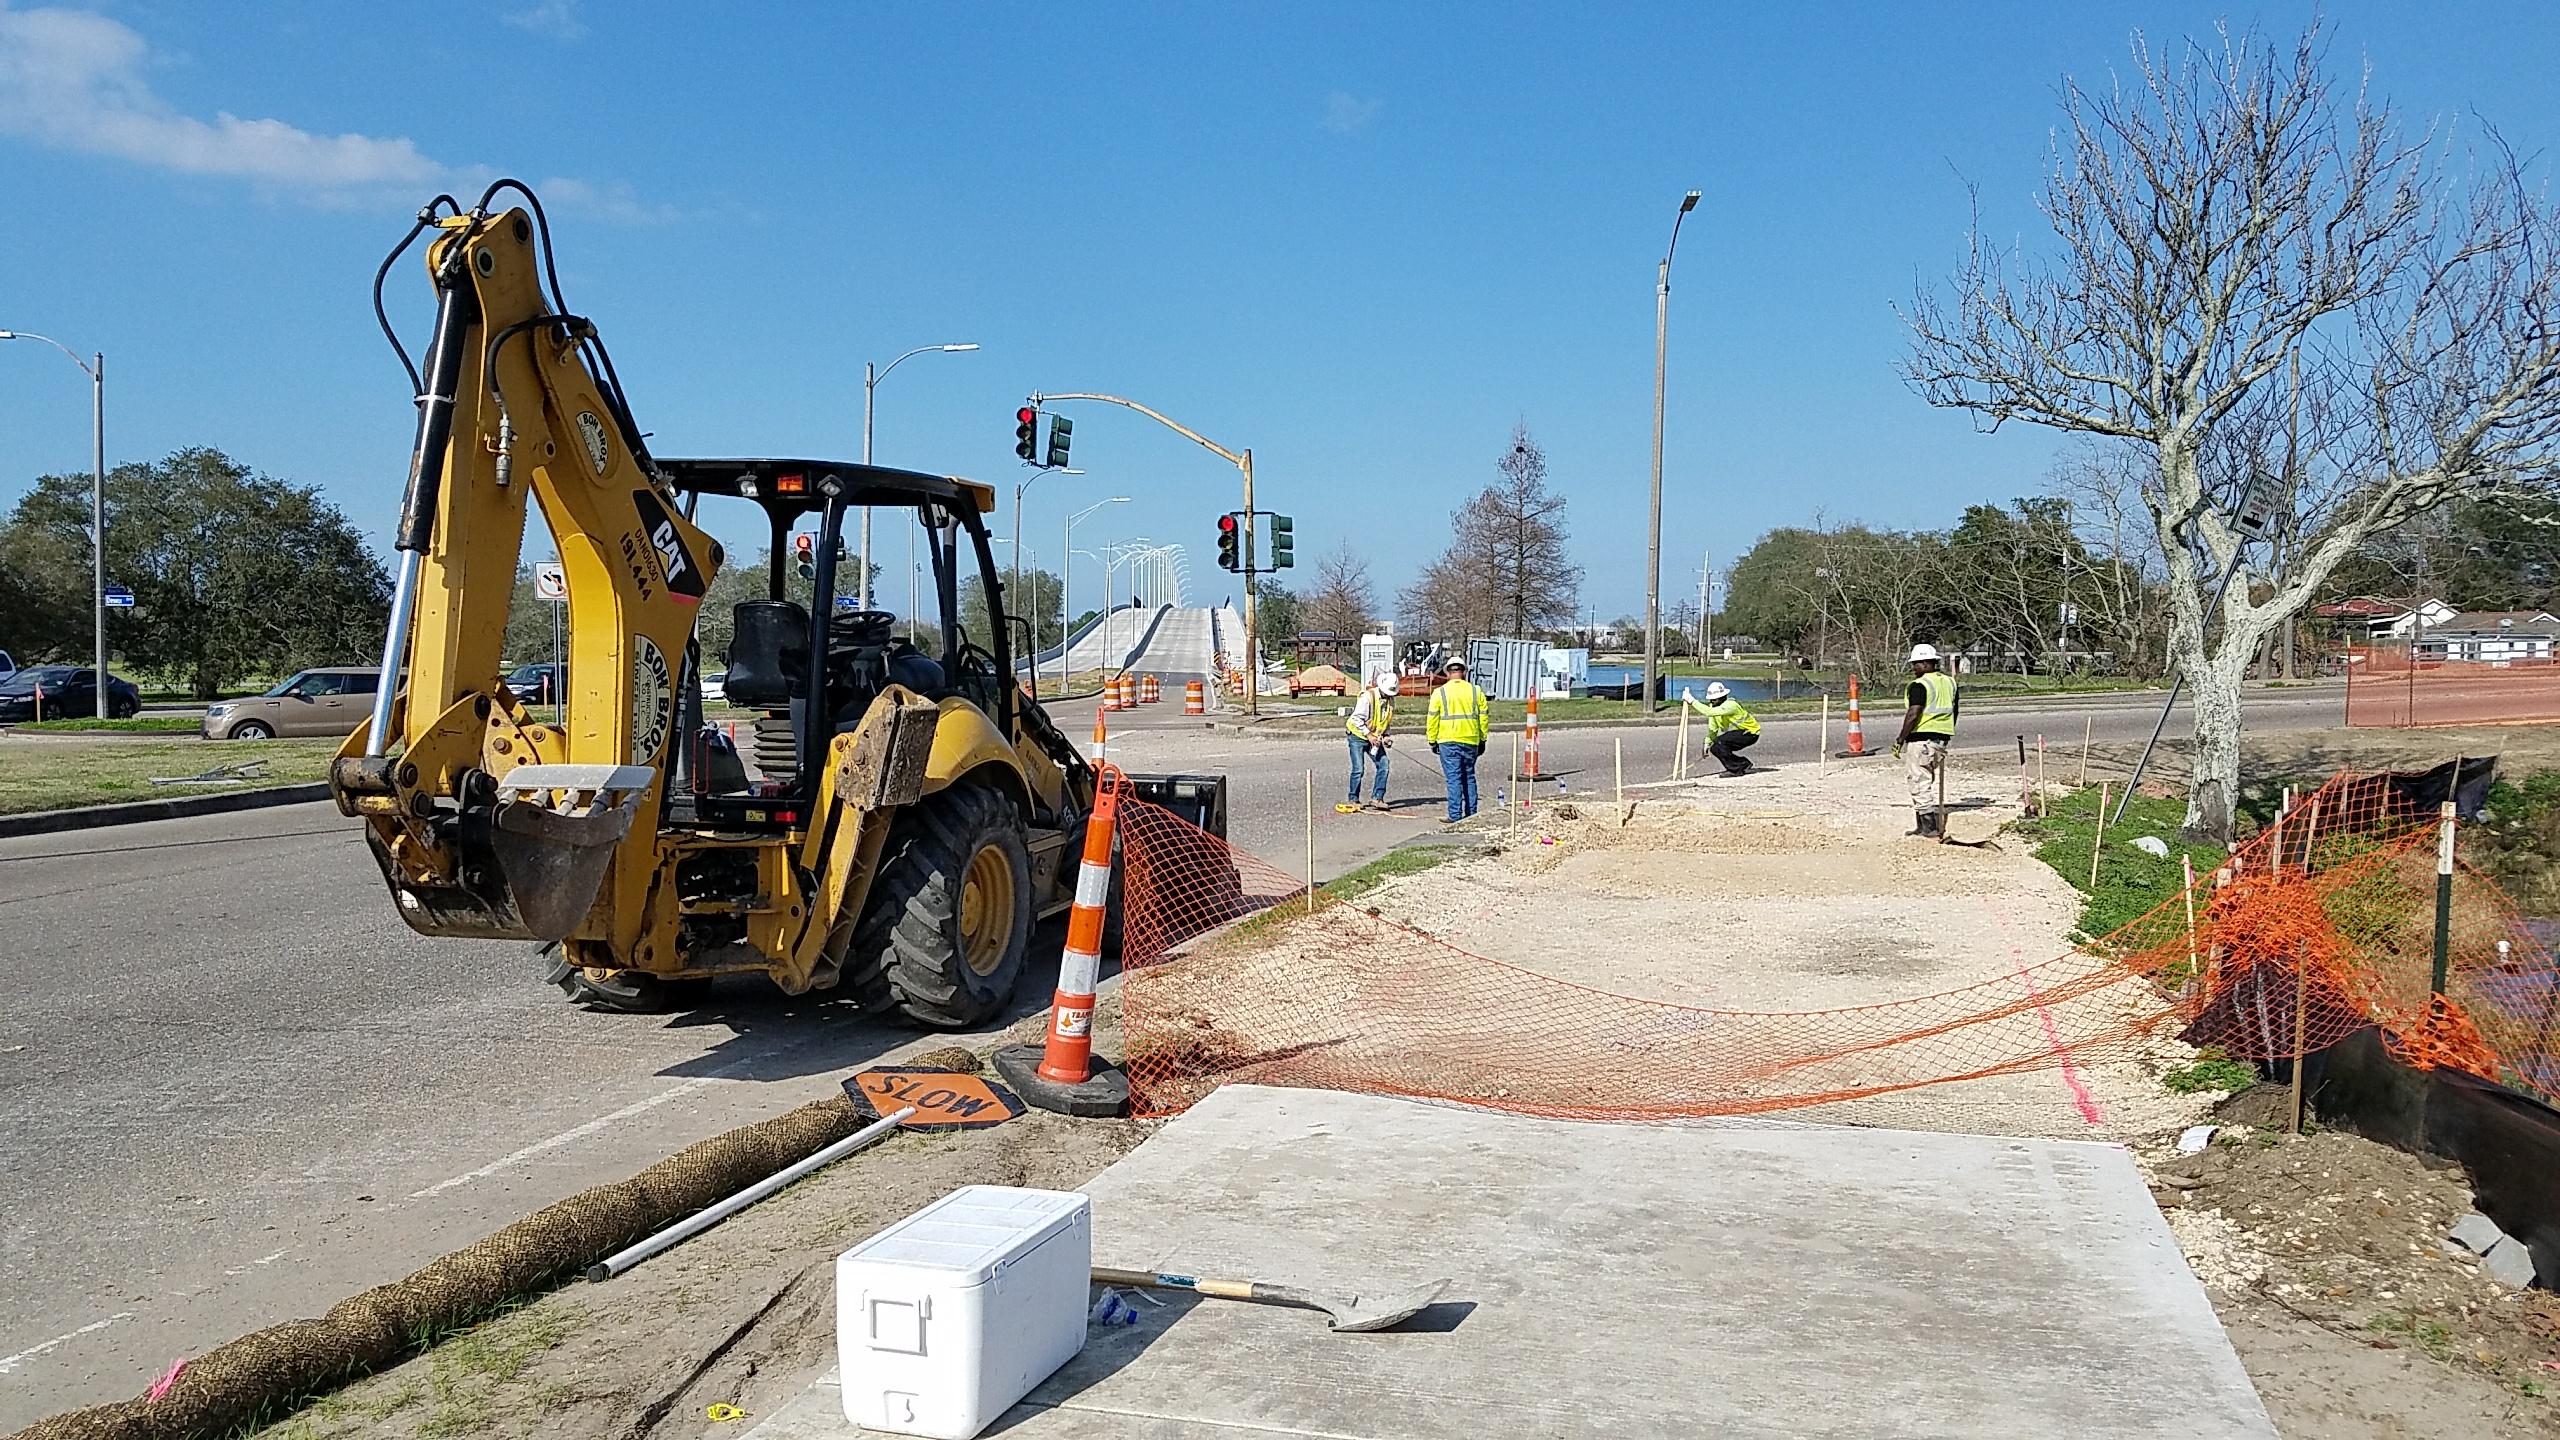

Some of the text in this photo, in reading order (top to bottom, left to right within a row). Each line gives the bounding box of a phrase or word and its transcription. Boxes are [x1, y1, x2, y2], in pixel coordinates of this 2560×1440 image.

[582, 413, 599, 430] BOH
[652, 519, 687, 584] CAT
[644, 642, 669, 690] BOH
[867, 1075, 996, 1118] SLOW
